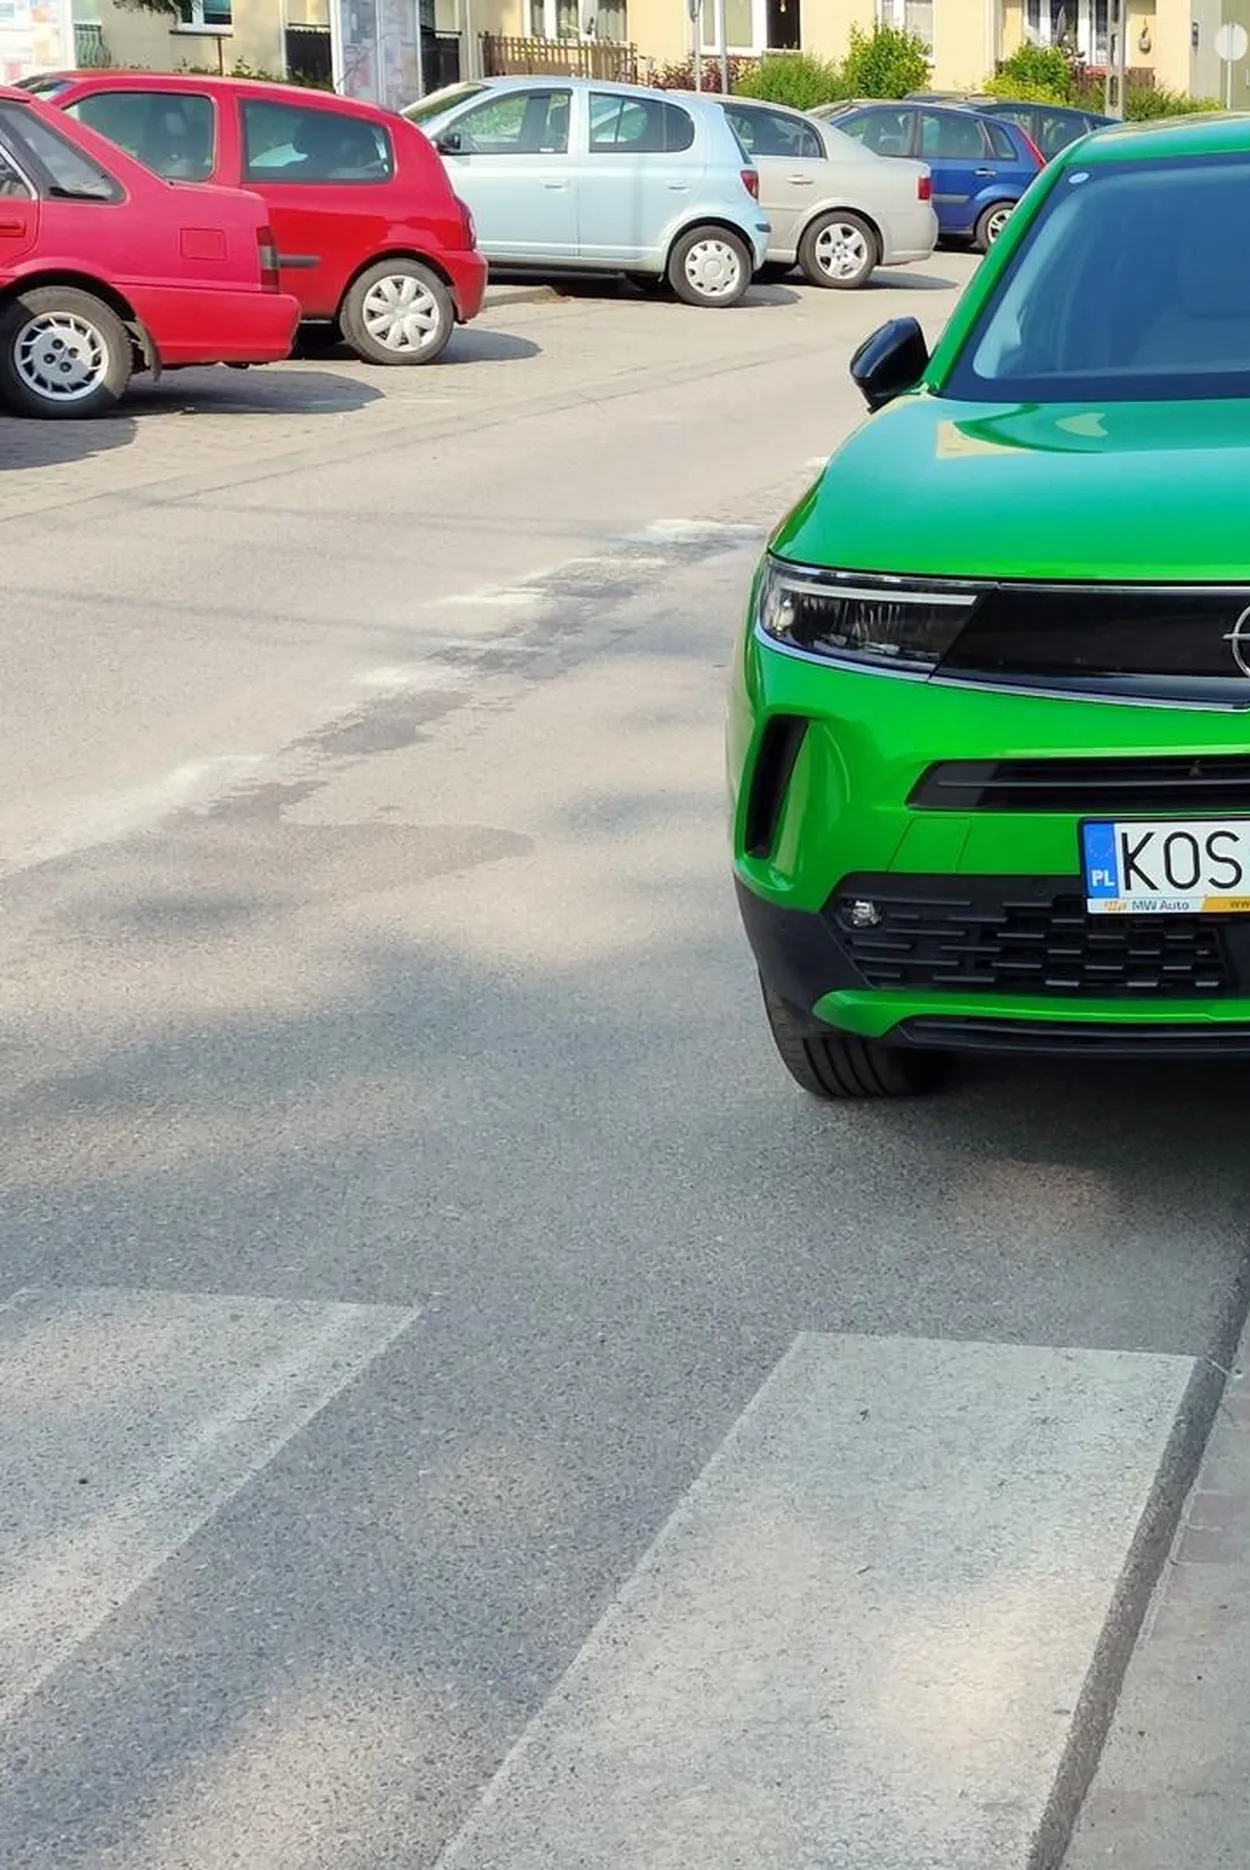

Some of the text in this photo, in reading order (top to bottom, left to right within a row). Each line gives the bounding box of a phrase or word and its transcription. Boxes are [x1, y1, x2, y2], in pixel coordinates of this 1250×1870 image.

[1121, 830, 1242, 891] KOS
[1091, 869, 1115, 887] PL
[1131, 900, 1157, 911] MW
[1159, 900, 1190, 911] Auto
